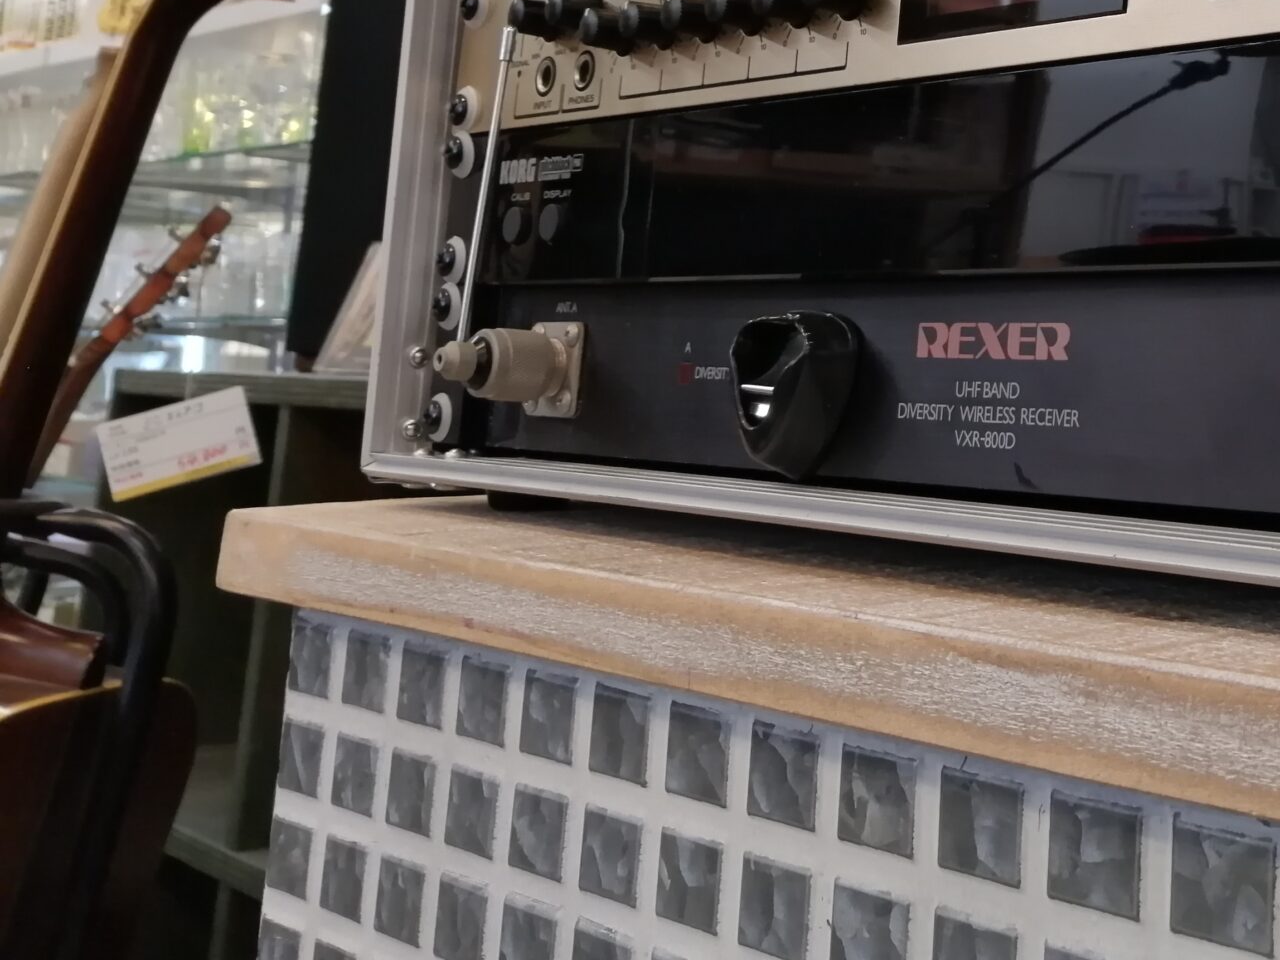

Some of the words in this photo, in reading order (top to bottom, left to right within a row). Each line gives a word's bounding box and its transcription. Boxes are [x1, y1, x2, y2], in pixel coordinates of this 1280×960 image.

[567, 94, 595, 105] PHONES
[499, 157, 537, 185] KORG
[543, 189, 572, 199] DISPLAY
[916, 322, 1071, 360] REXER
[694, 366, 734, 380] DIVERSIT
[955, 381, 983, 398] UHF
[984, 383, 1020, 399] BAND
[898, 403, 953, 422] DIVERSITY
[960, 406, 1015, 425] WIRELESS
[1020, 408, 1079, 428] RECEIVER
[955, 430, 1016, 449] VXR-800D
